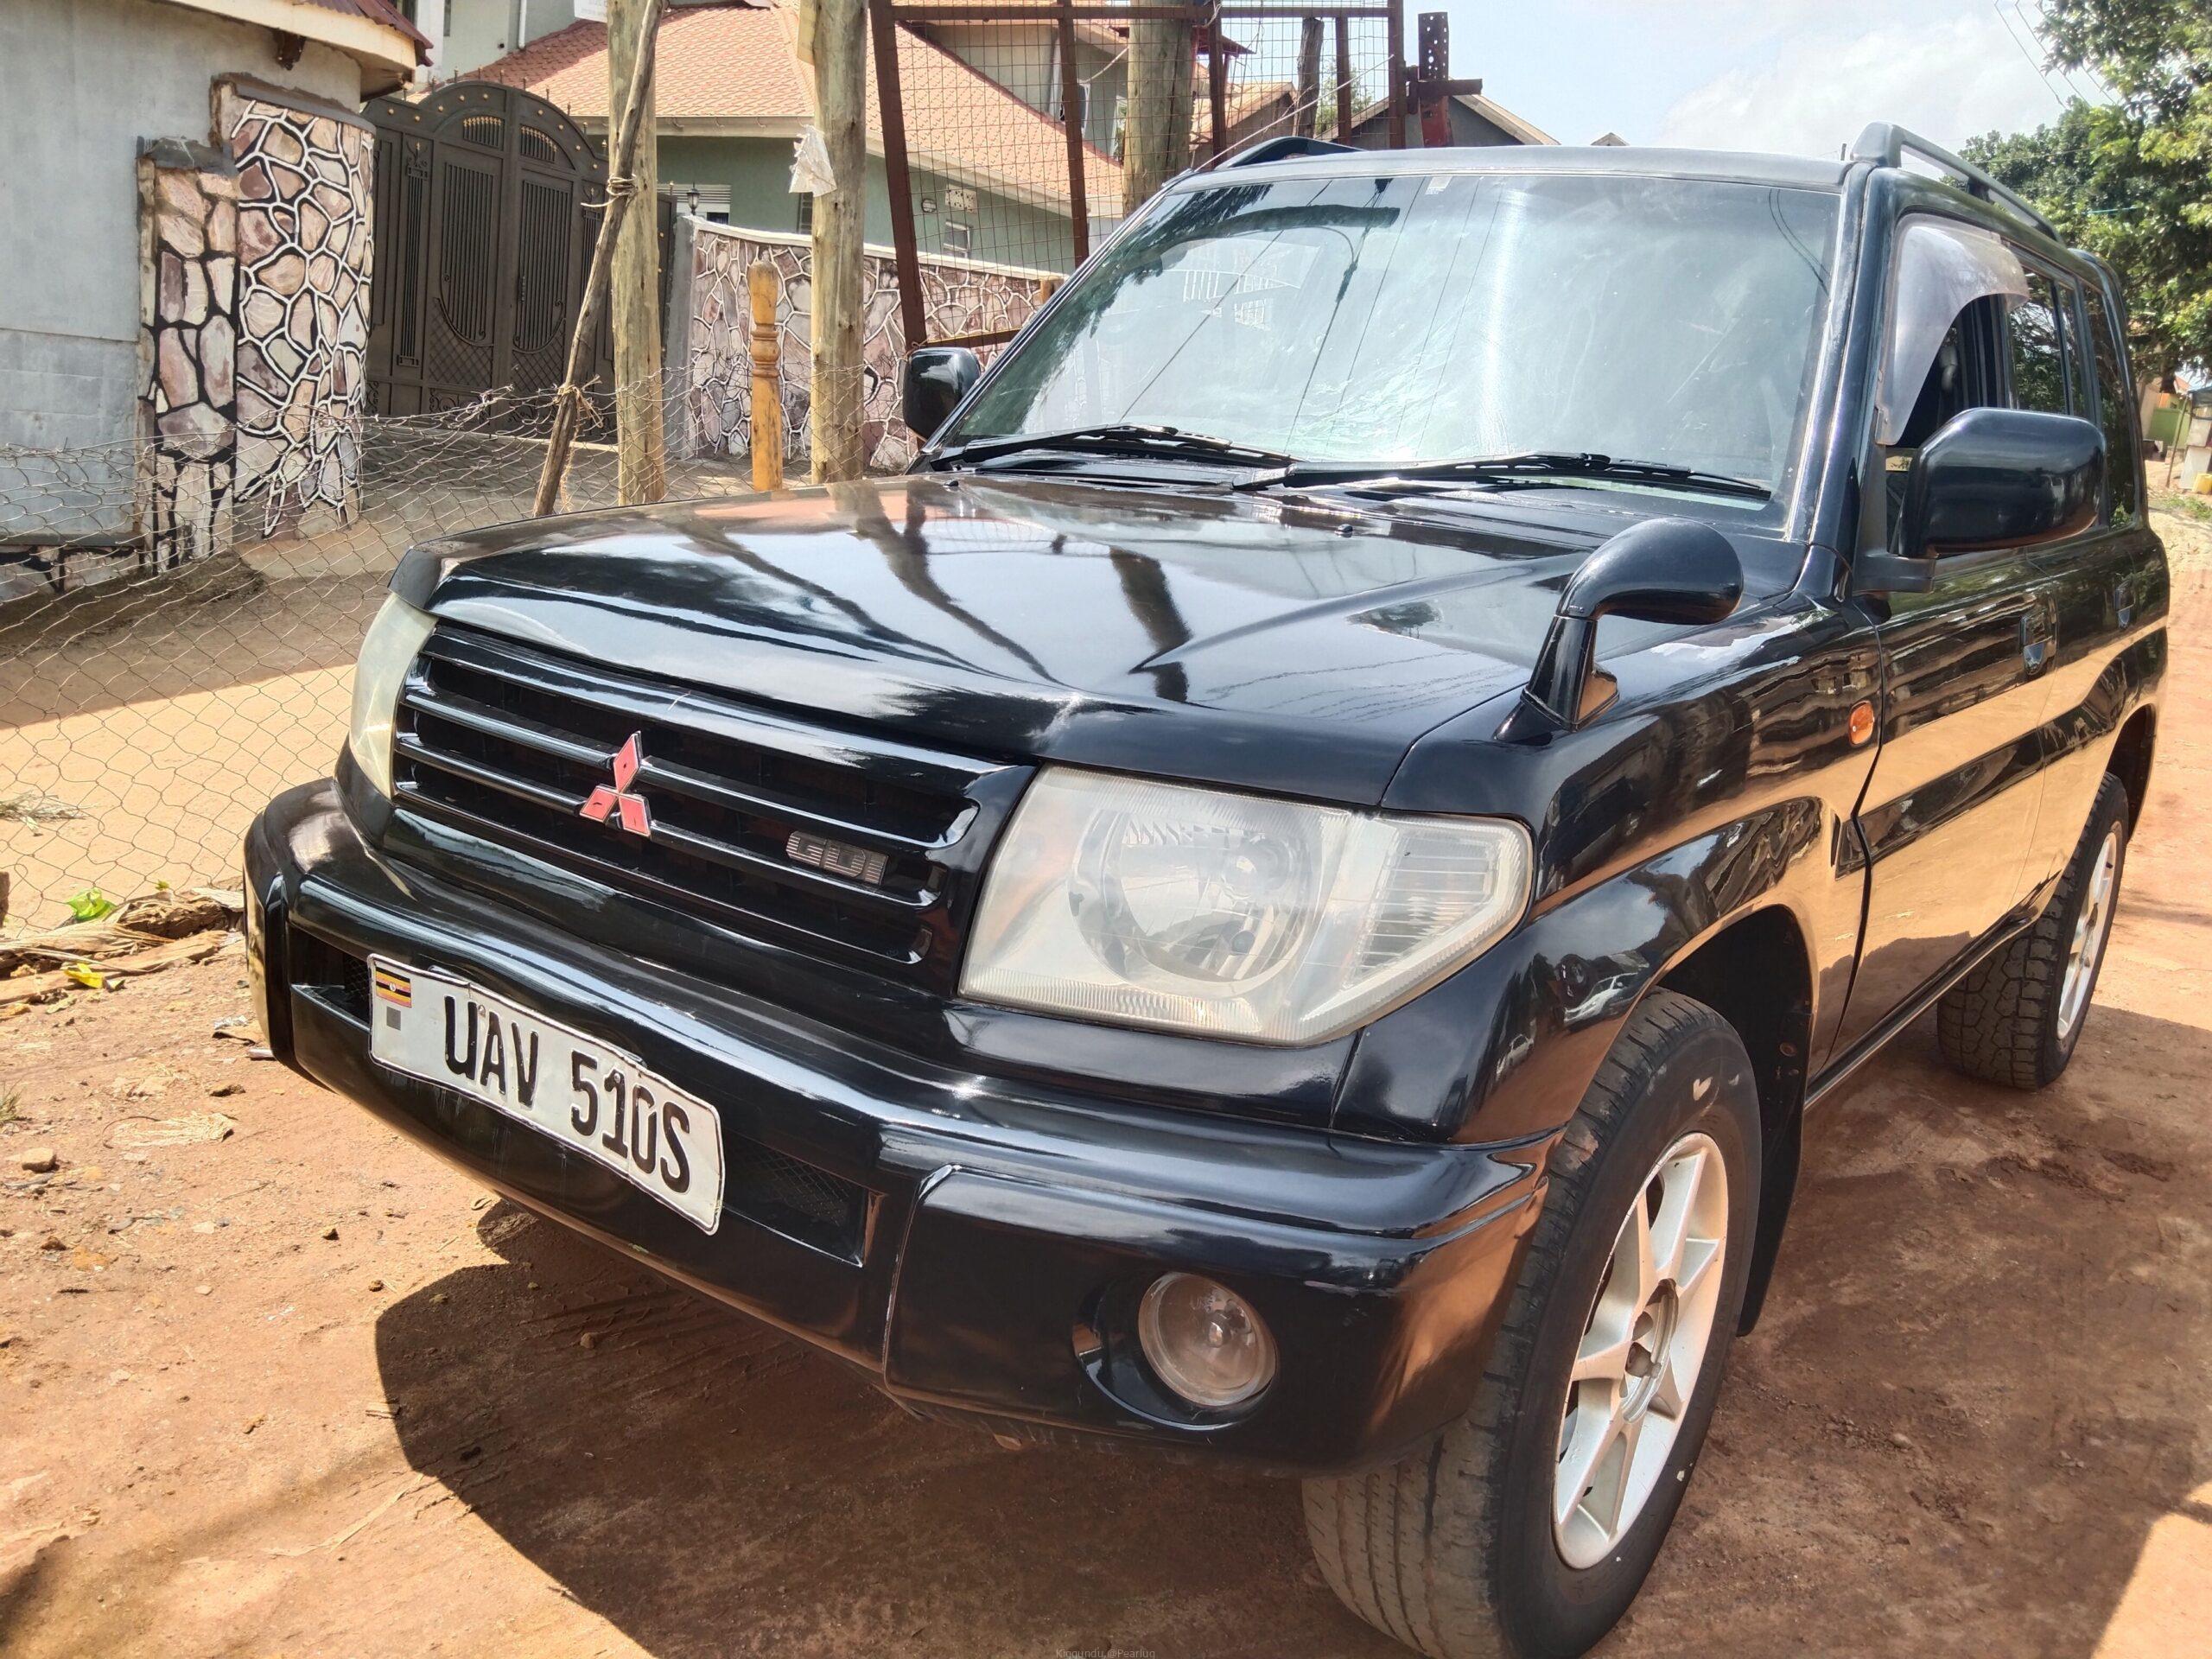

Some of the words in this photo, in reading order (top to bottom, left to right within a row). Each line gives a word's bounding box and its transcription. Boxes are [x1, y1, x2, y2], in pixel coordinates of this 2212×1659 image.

[785, 830, 888, 886] GDI
[444, 995, 539, 1109] UAV
[570, 1049, 690, 1193] 510S
